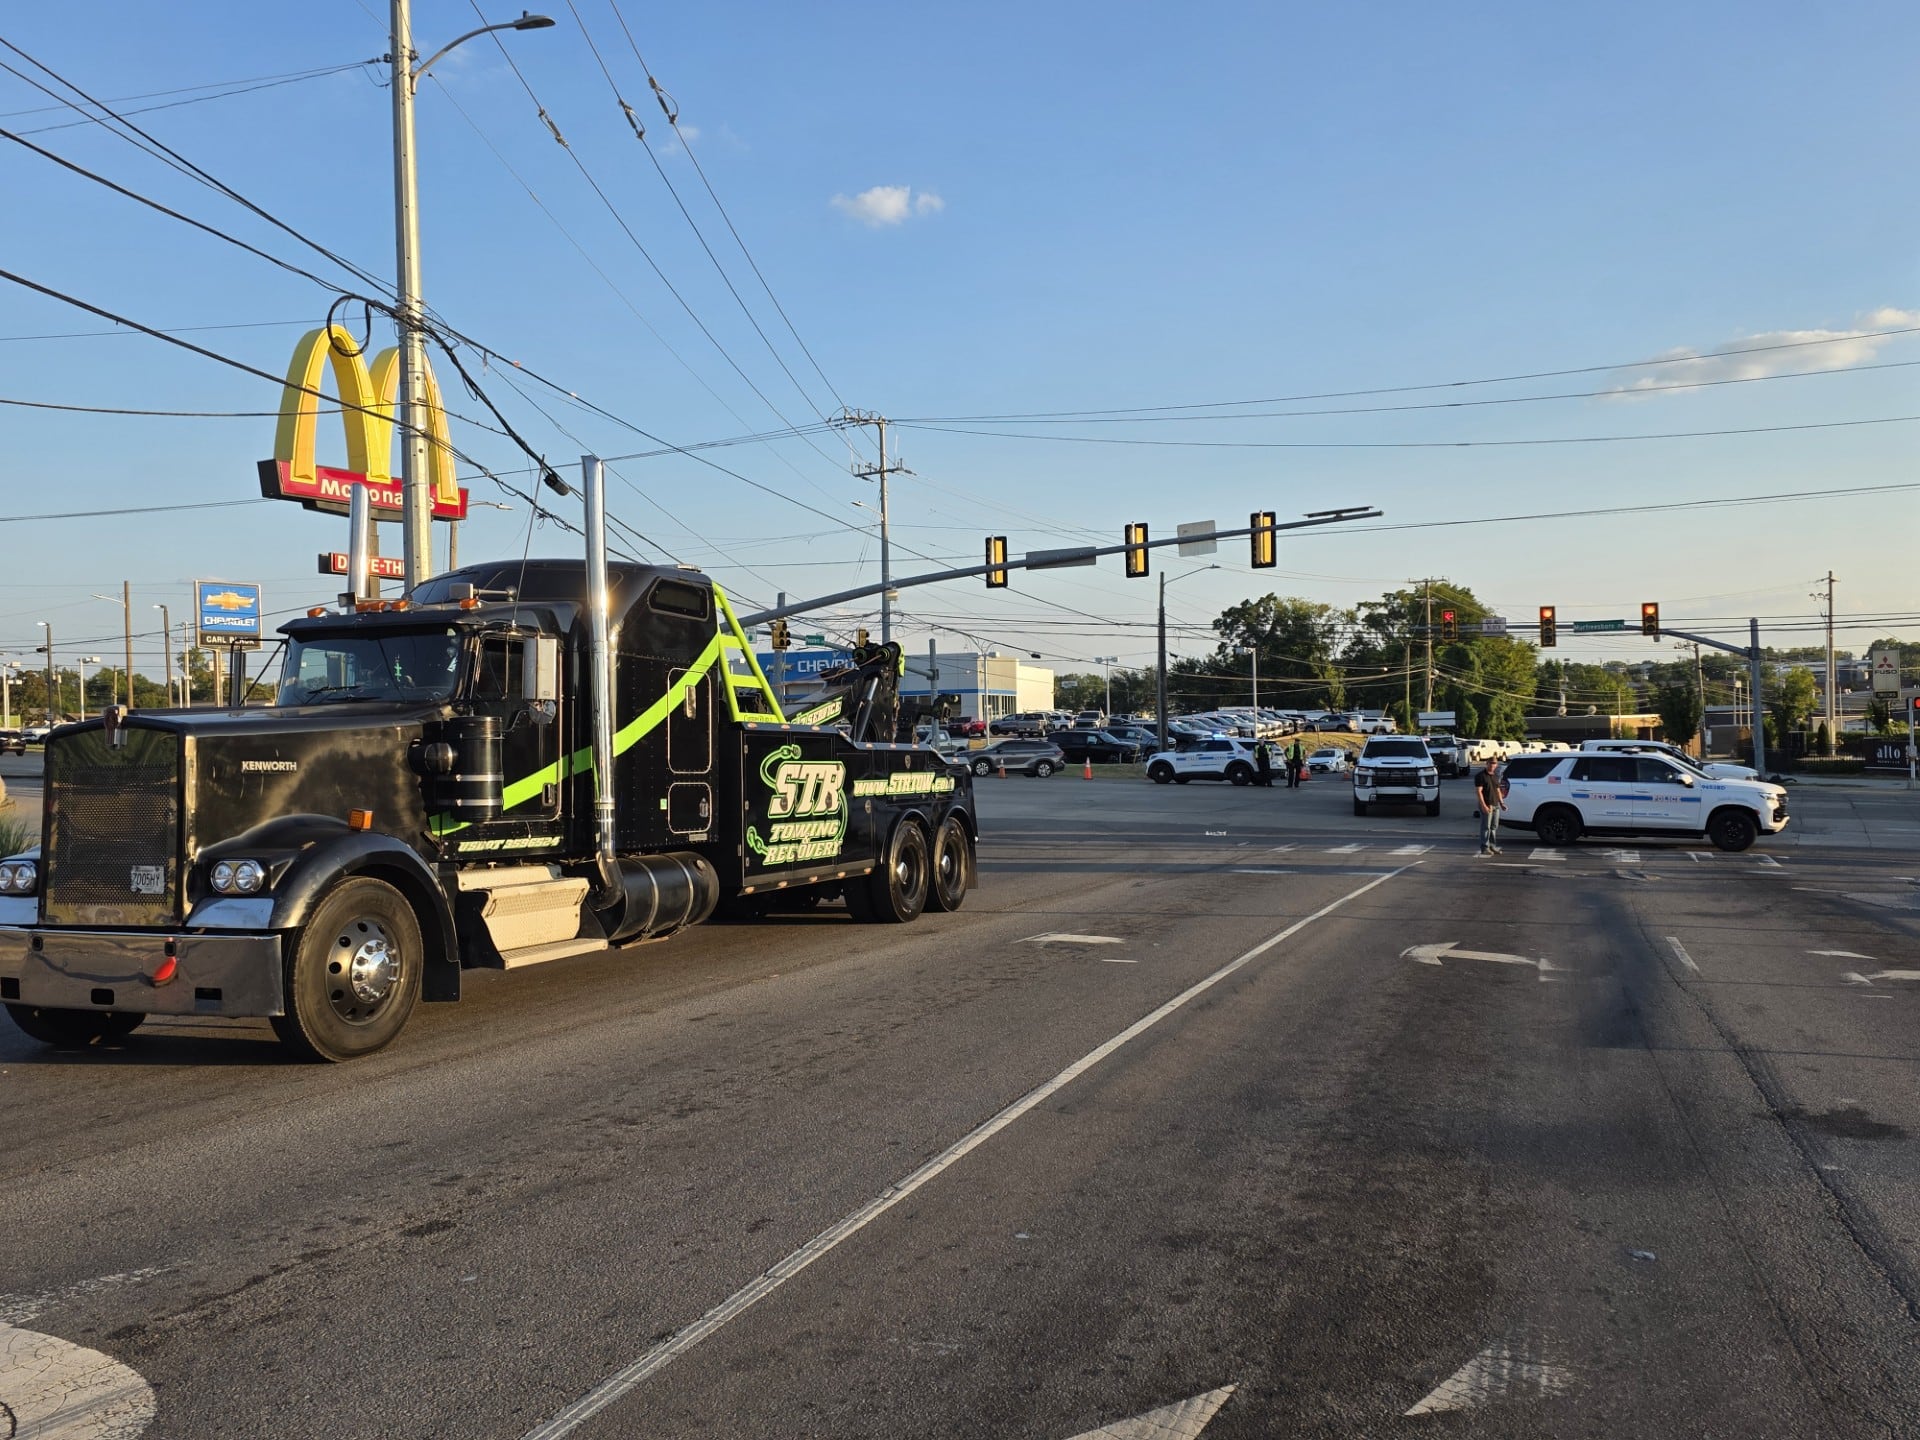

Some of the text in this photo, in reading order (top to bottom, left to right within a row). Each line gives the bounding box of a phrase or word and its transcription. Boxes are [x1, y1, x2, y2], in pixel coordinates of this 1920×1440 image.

[204, 616, 255, 627] CHEVROLET
[206, 635, 227, 643] CARL
[241, 761, 297, 771] KENWORTH
[769, 761, 845, 818] STR
[769, 820, 841, 843] TOWING
[763, 841, 843, 866] RECOVERY
